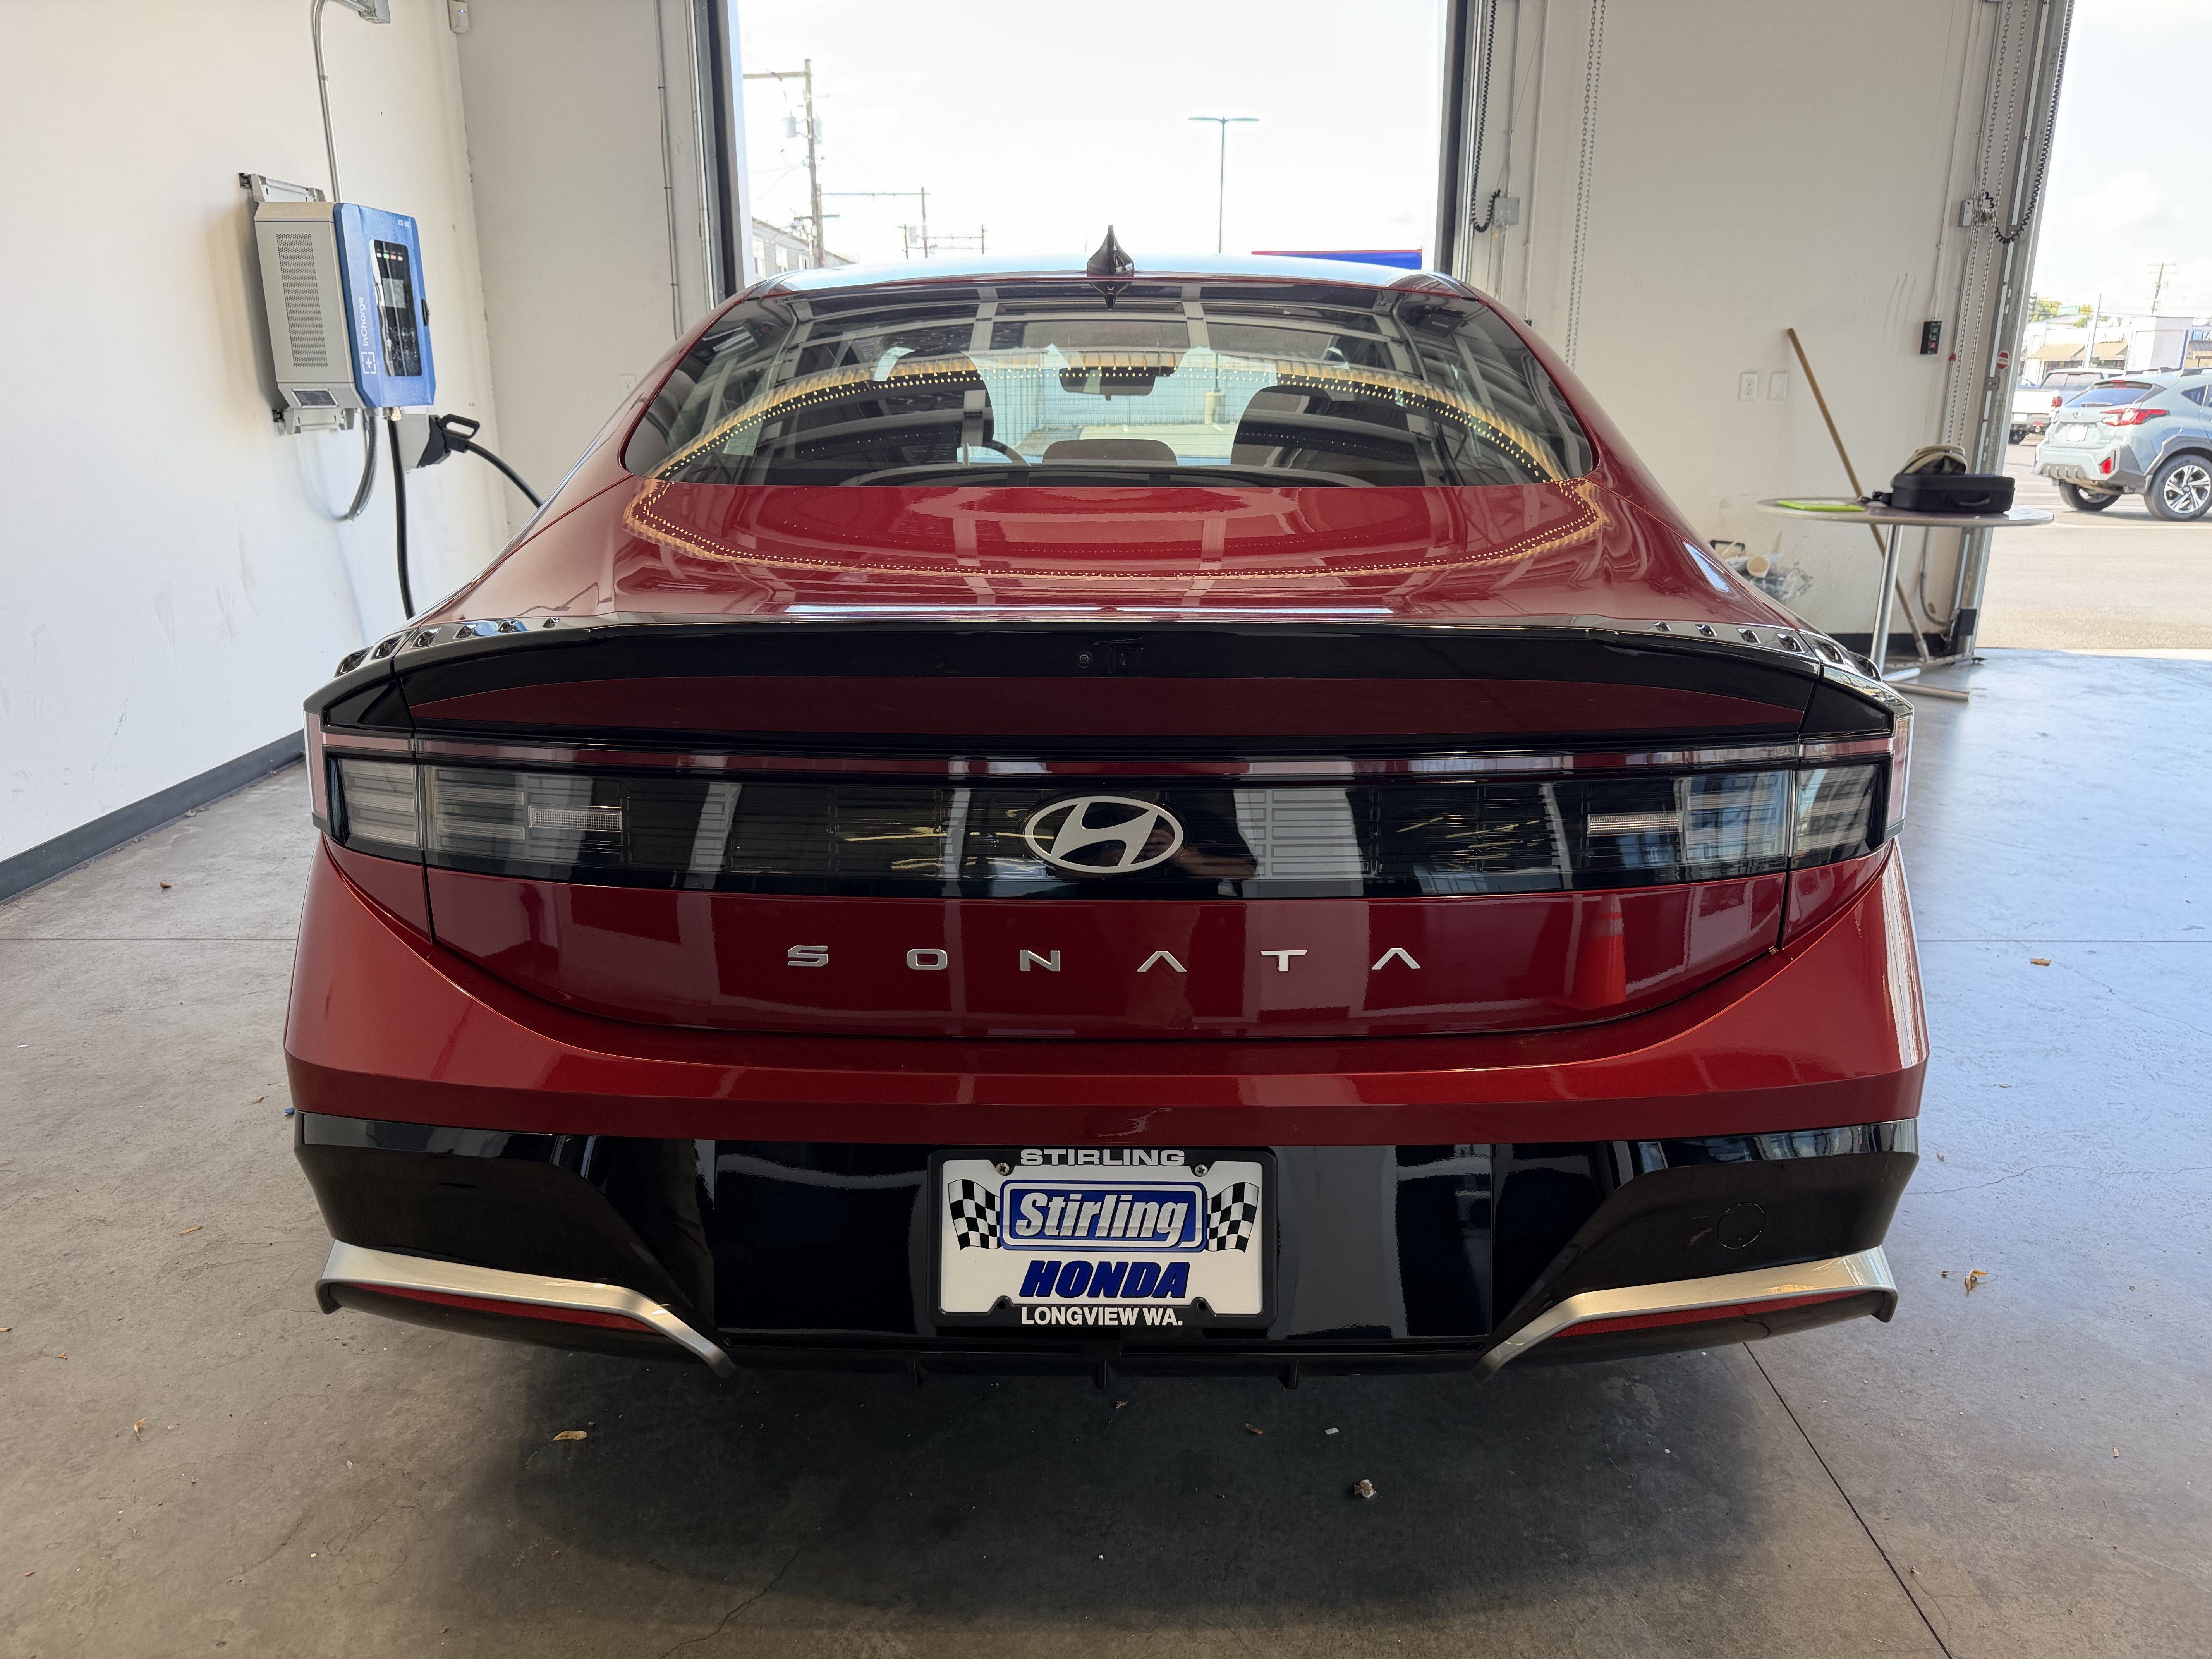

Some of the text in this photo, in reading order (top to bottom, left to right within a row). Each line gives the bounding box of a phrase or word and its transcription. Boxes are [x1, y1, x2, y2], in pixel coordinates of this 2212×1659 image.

[358, 297, 369, 346] InCharge
[787, 945, 1421, 972] SONATA
[1020, 1149, 1185, 1166] STIRLING
[1015, 1192, 1188, 1247] Stirling
[1018, 1260, 1190, 1298] HONDA
[1022, 1307, 1183, 1326] LONGVIEW WA.
